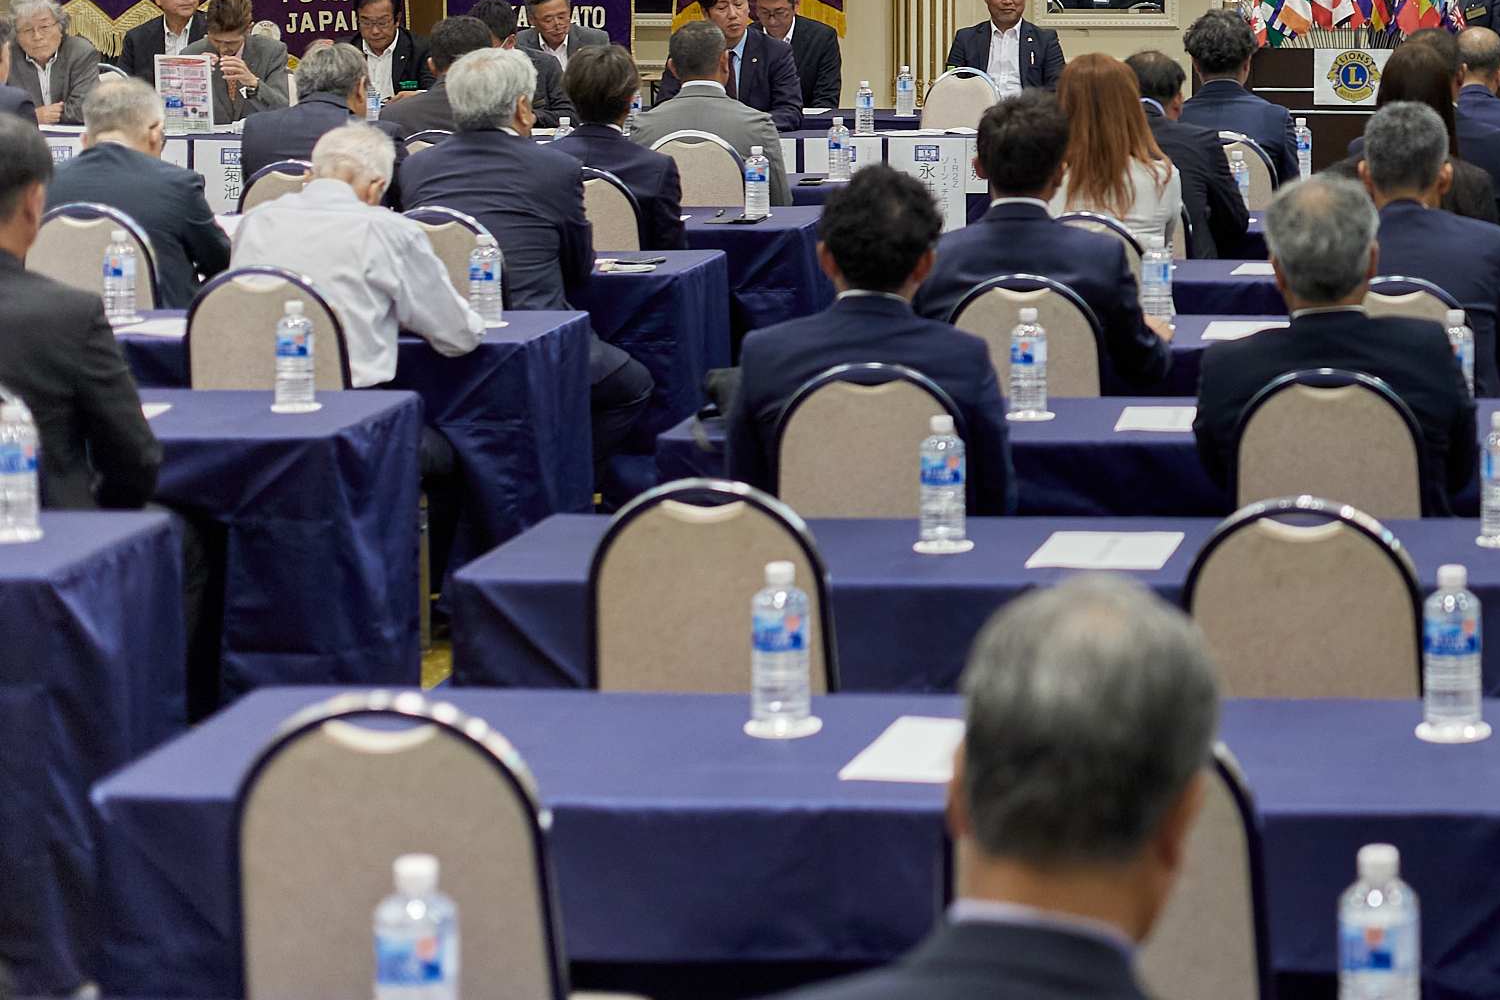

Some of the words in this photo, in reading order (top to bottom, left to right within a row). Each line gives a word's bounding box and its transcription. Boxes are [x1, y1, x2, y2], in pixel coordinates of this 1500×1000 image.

[1339, 53, 1371, 64] LIONS
[1348, 66, 1363, 85] L
[224, 167, 241, 200] 菊池
